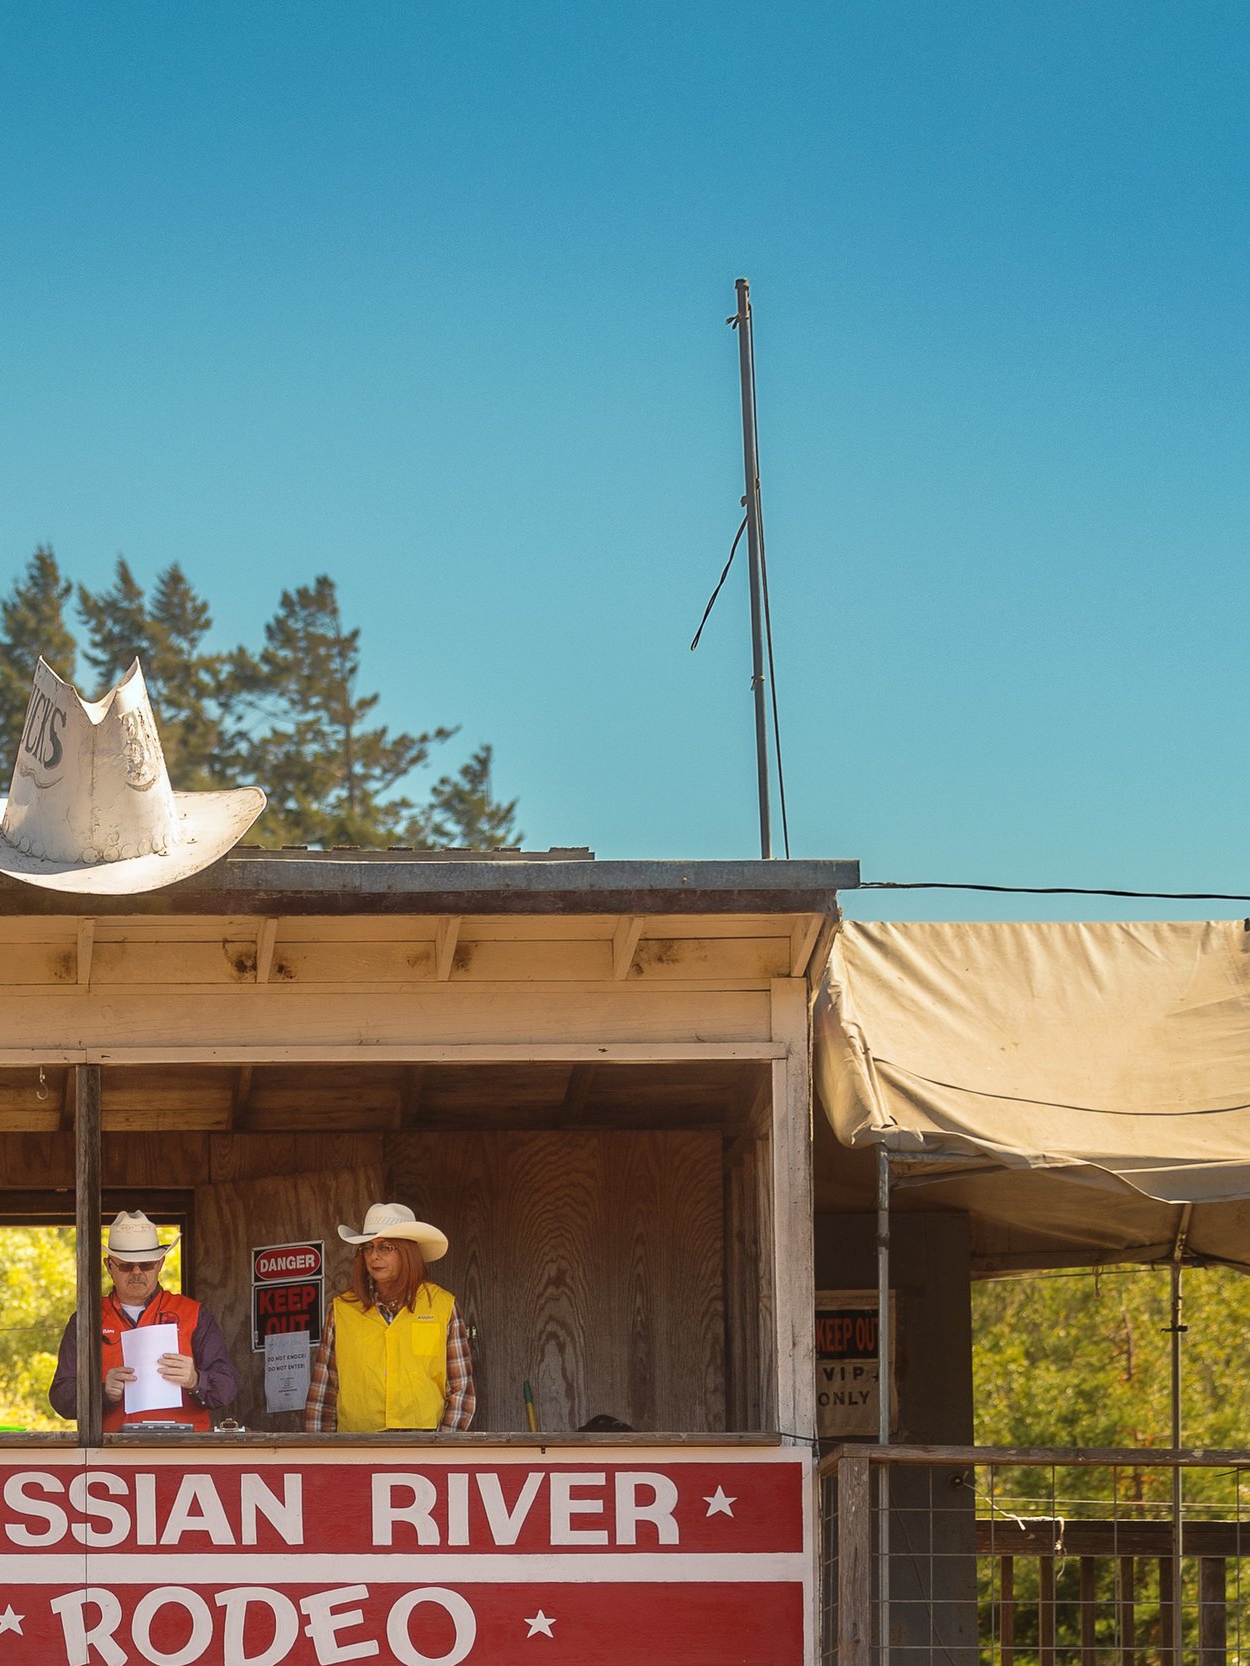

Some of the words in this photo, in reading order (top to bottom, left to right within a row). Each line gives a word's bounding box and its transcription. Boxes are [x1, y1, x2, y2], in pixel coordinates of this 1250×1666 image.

[260, 1254, 315, 1272] DANGER
[259, 1285, 316, 1315] KEEP
[266, 1314, 310, 1335] OUT
[816, 1318, 851, 1352] KEEP
[823, 1366, 865, 1381] VIP
[818, 1391, 870, 1407] ONLY
[371, 1472, 680, 1547] RIVER
